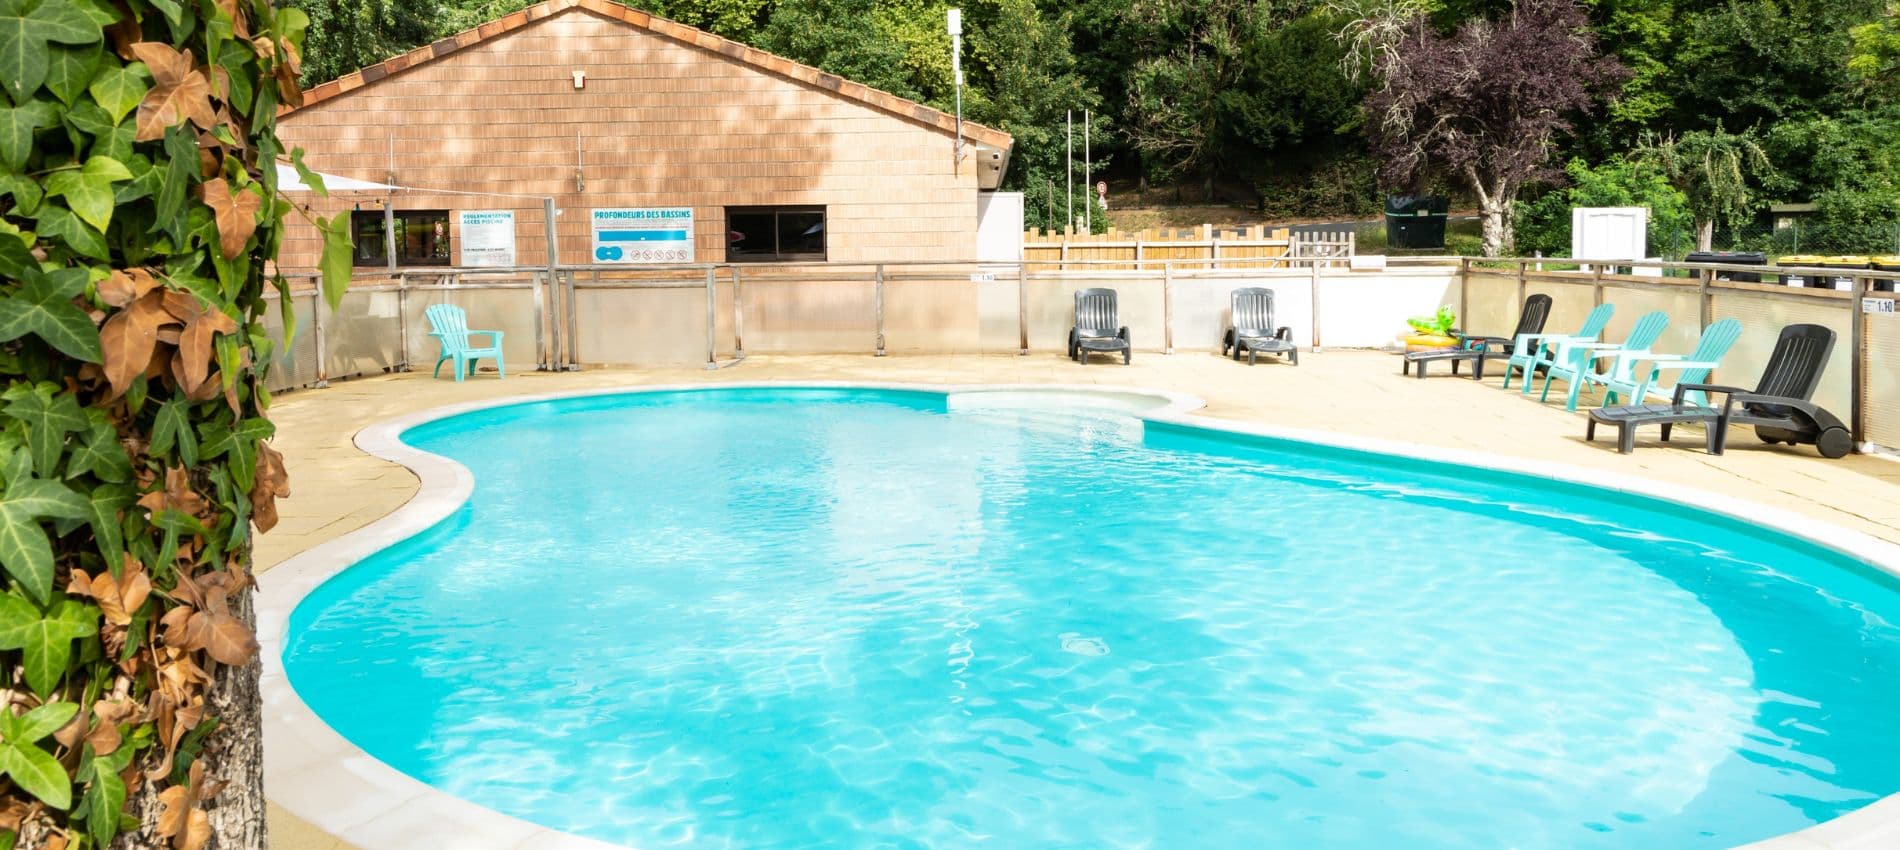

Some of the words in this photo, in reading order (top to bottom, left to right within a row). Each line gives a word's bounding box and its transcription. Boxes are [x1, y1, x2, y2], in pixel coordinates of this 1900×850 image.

[594, 211, 645, 219] PROFONDEURS
[661, 210, 691, 218] BASSINS
[1878, 301, 1893, 312] 1.10
